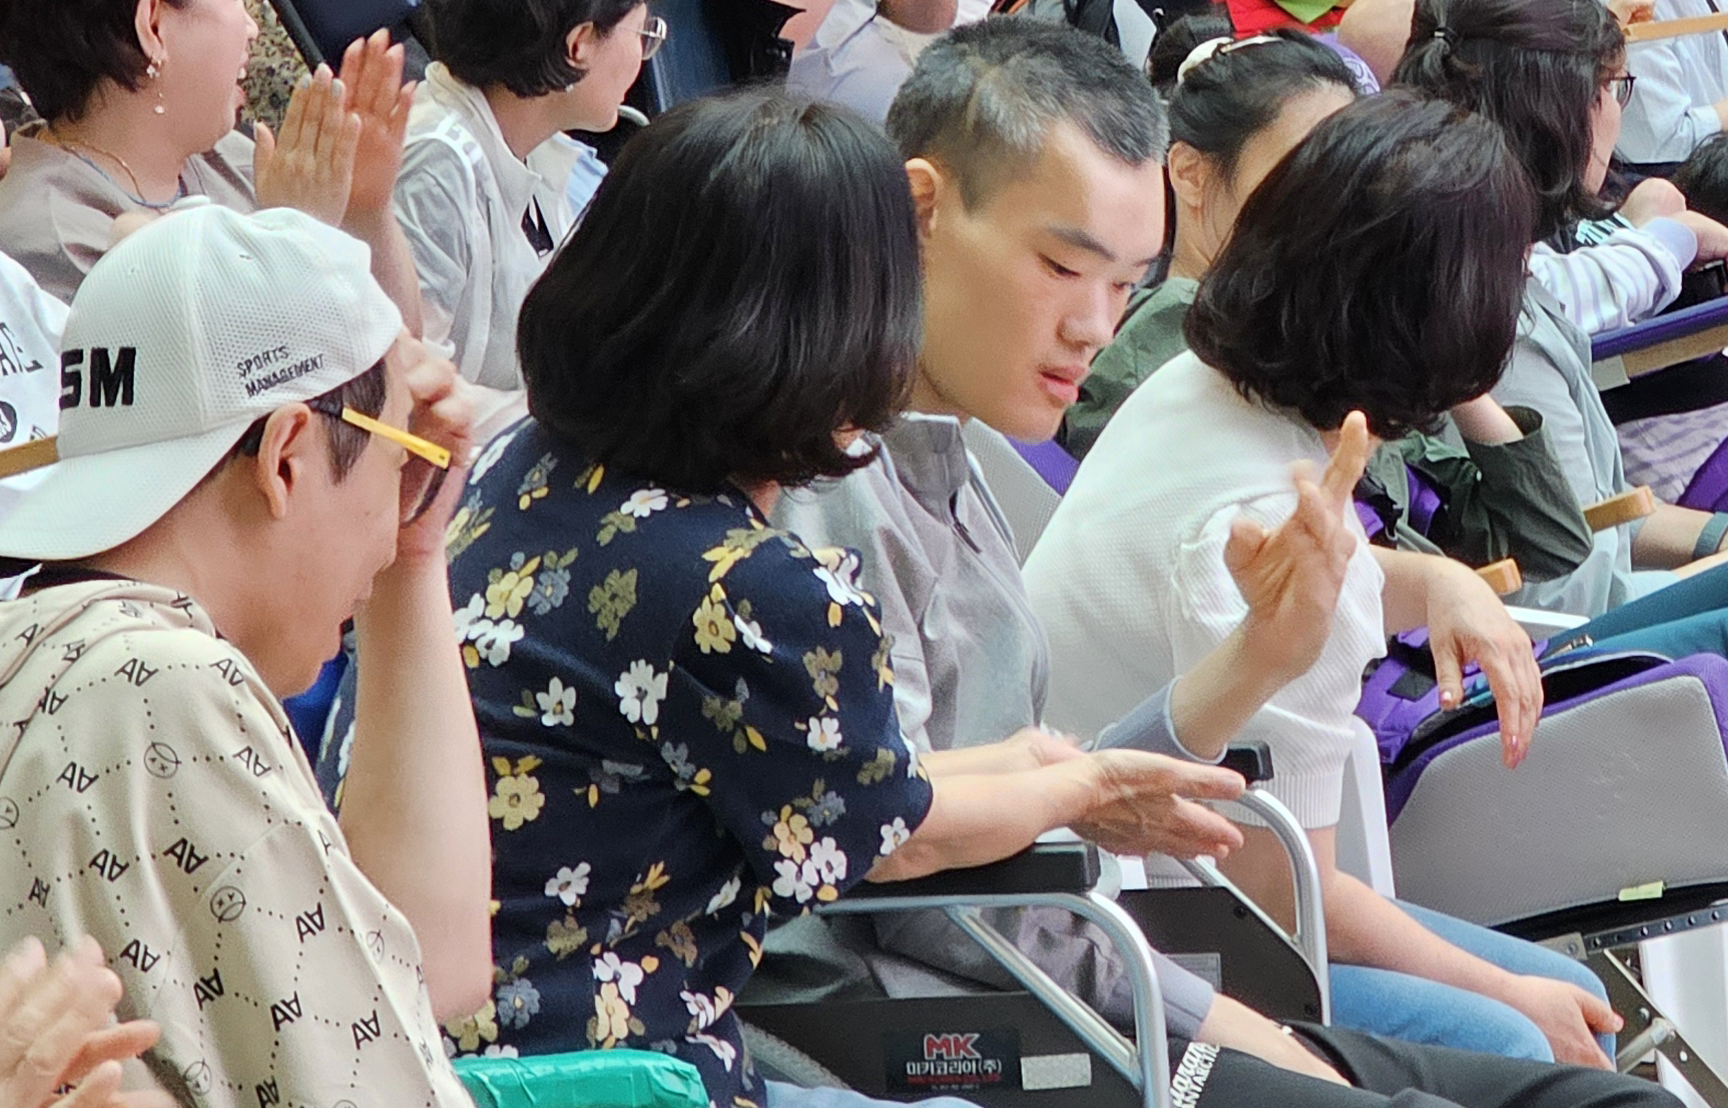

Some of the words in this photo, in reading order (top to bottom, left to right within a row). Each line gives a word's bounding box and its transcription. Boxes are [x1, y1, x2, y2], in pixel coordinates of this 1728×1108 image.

[237, 345, 289, 379] SPORTS
[245, 353, 324, 398] MANAGEMENT
[924, 1032, 982, 1061] MK
